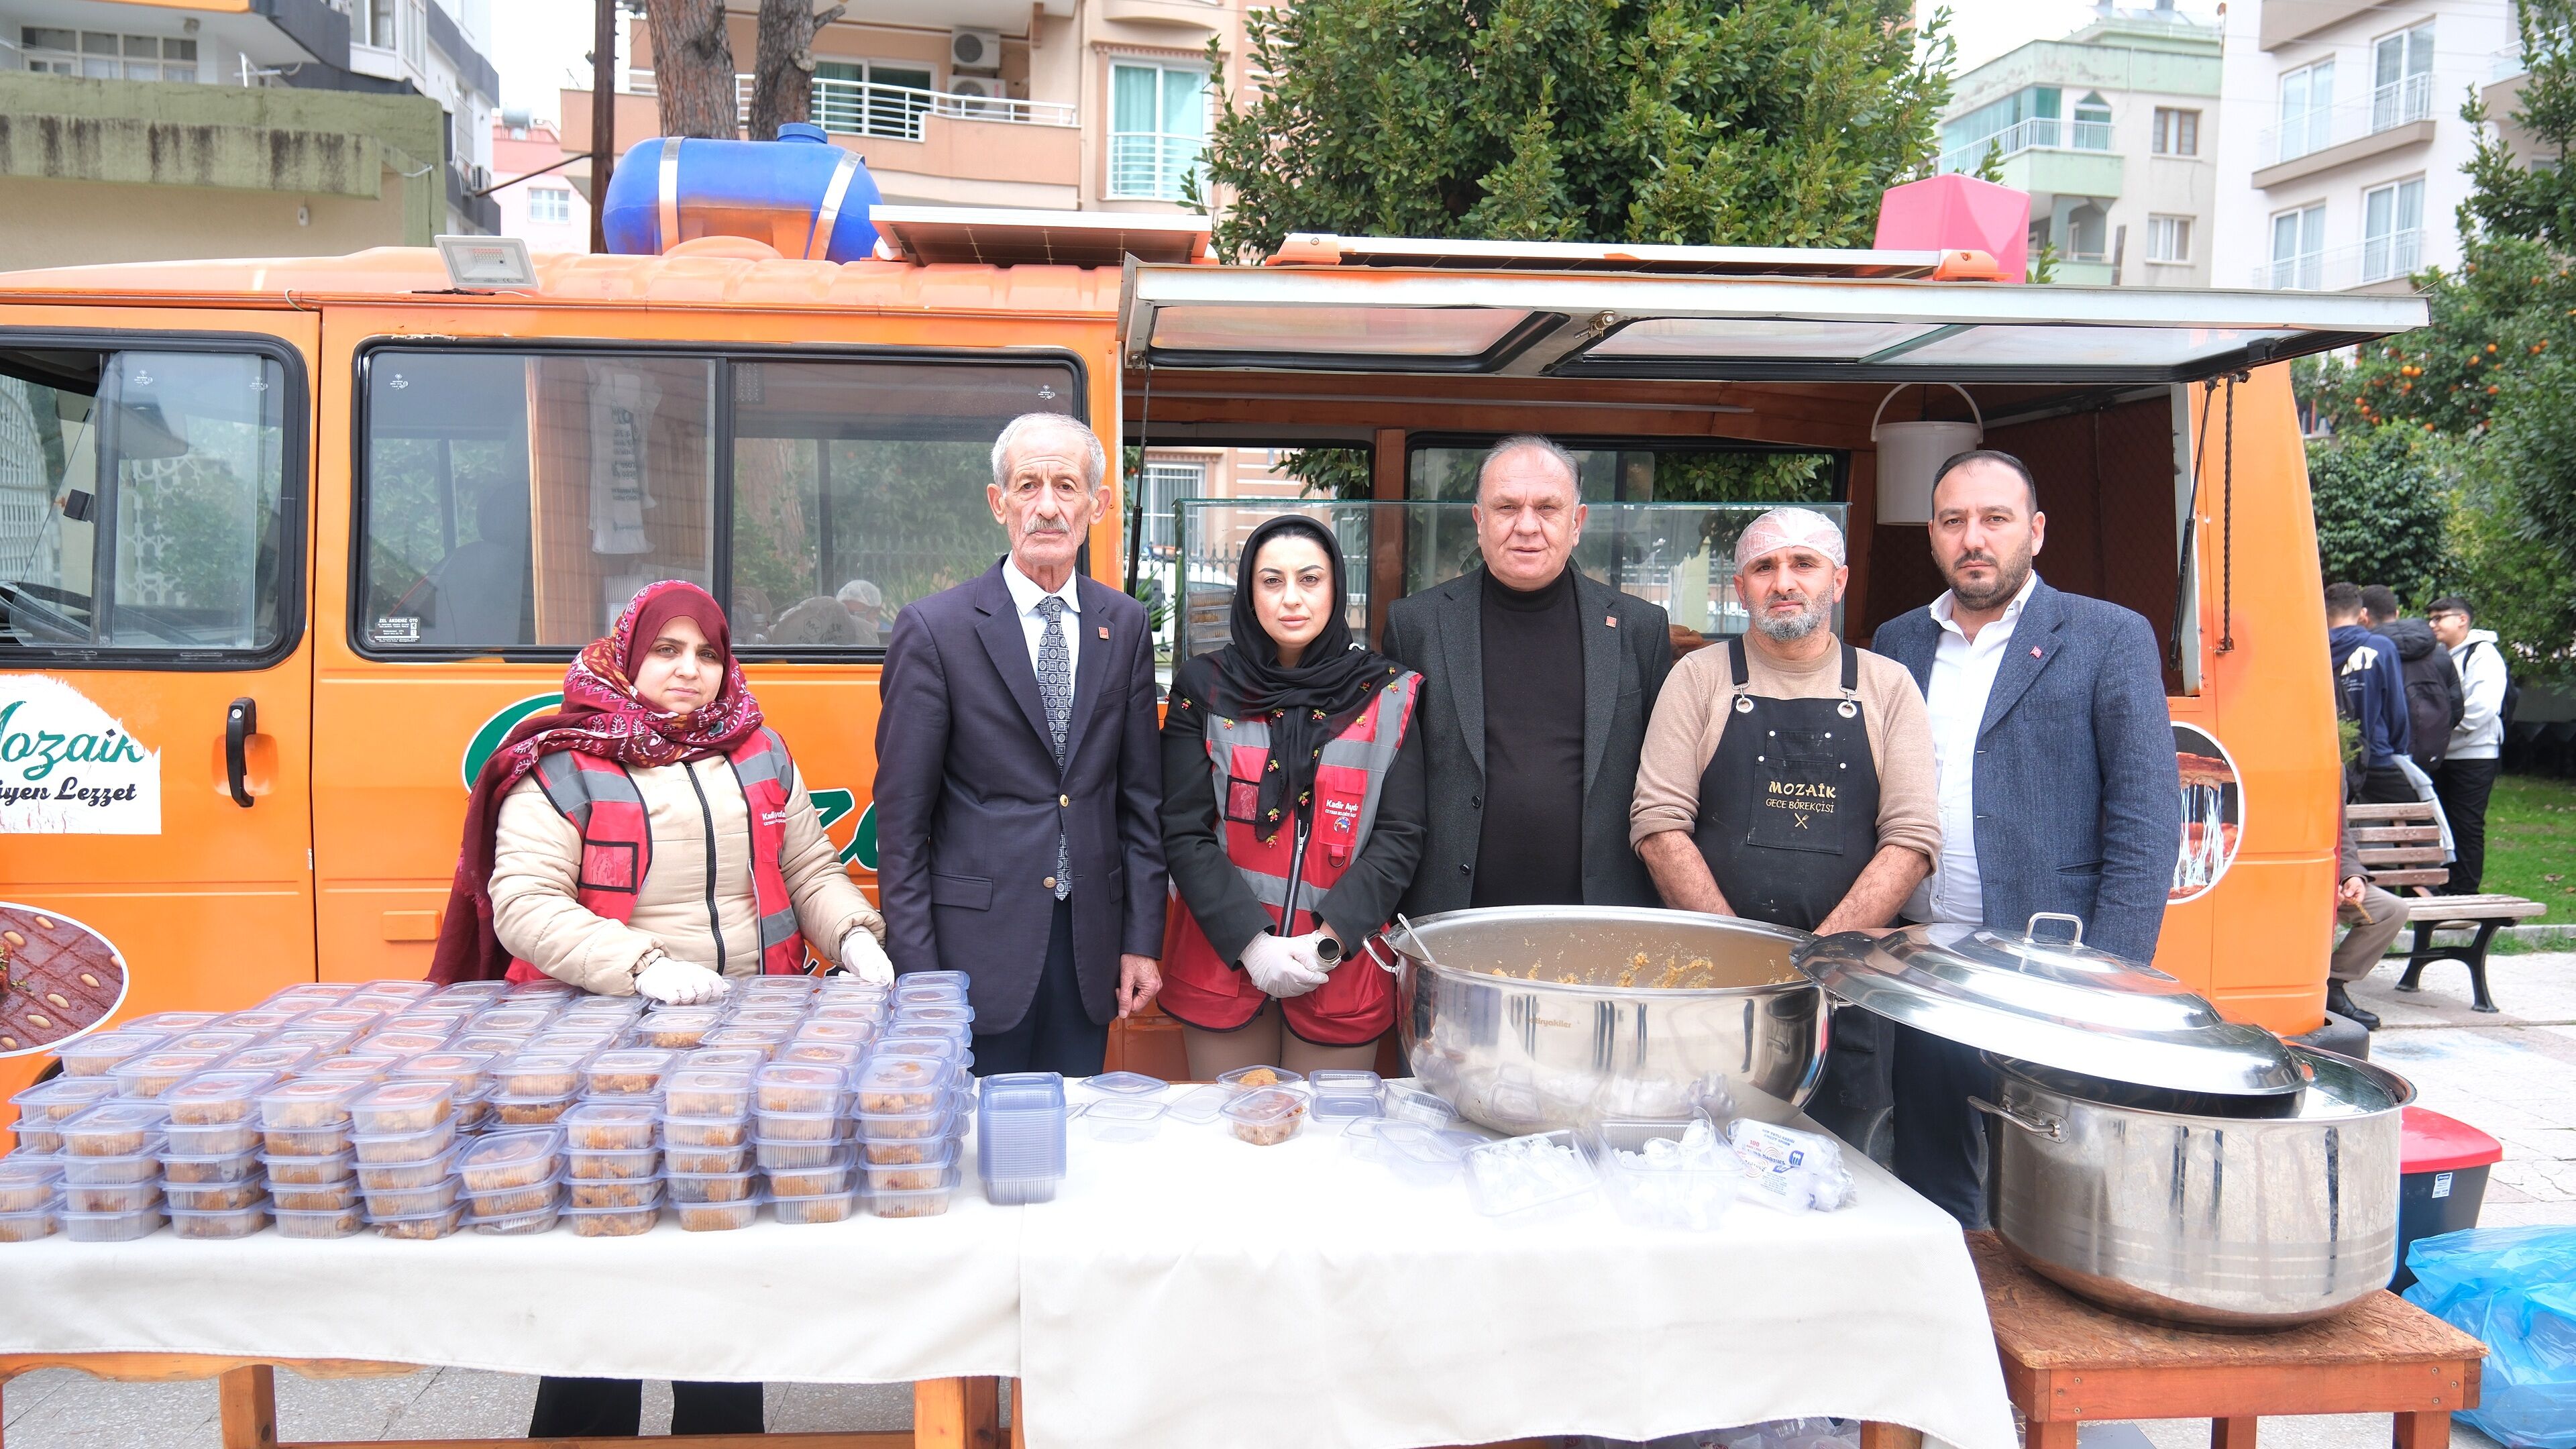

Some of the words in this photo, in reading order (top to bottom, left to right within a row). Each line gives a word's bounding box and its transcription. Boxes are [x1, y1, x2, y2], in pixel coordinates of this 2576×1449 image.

[54, 776, 137, 807] Lezzet
[1768, 781, 1836, 798] MOZAİK
[1326, 799, 1344, 809] Kadir
[1766, 798, 1787, 808] GECE
[1788, 799, 1834, 813] BÖREKÇİSİ
[1750, 1139, 1760, 1147] 100
